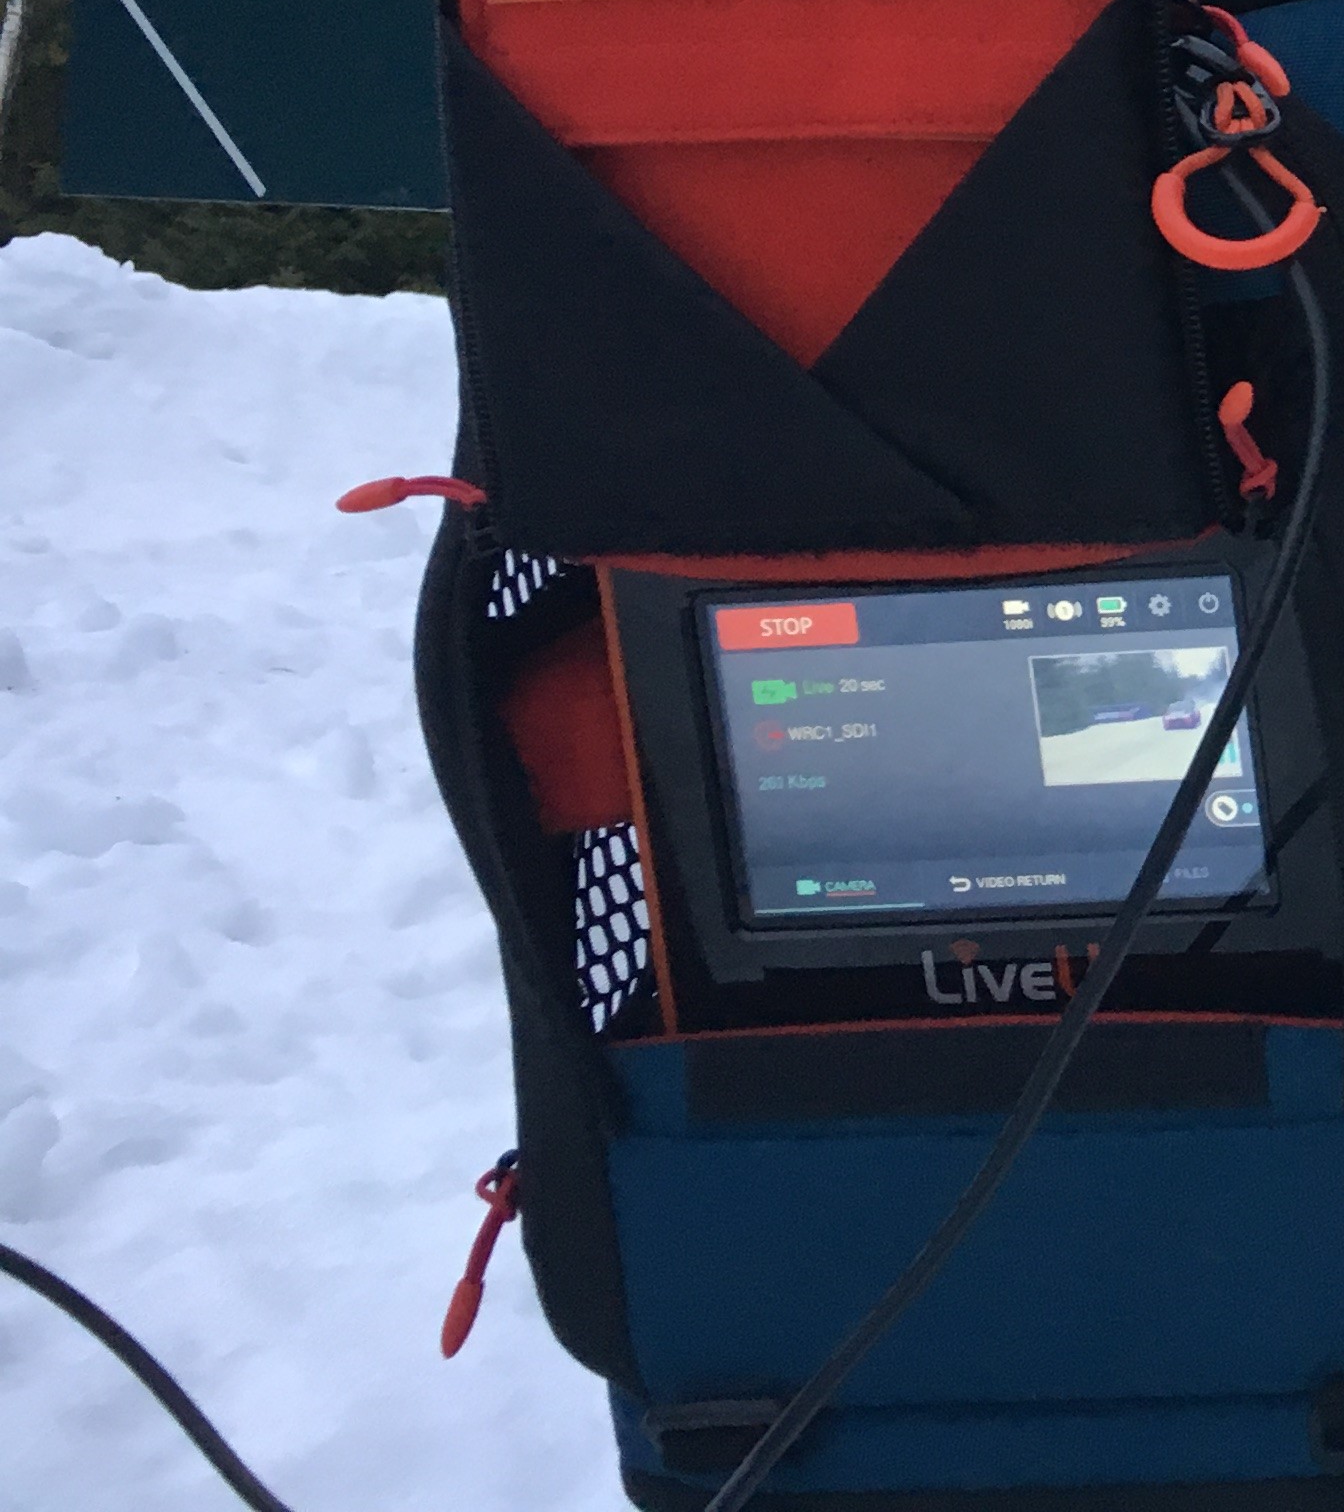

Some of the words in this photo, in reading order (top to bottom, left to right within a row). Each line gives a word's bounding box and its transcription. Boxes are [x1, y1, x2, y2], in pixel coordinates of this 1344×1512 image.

[760, 617, 813, 637] STOP
[825, 879, 877, 893] CAMERA
[975, 875, 1014, 888] VIDEO
[1016, 873, 1066, 887] RETURN
